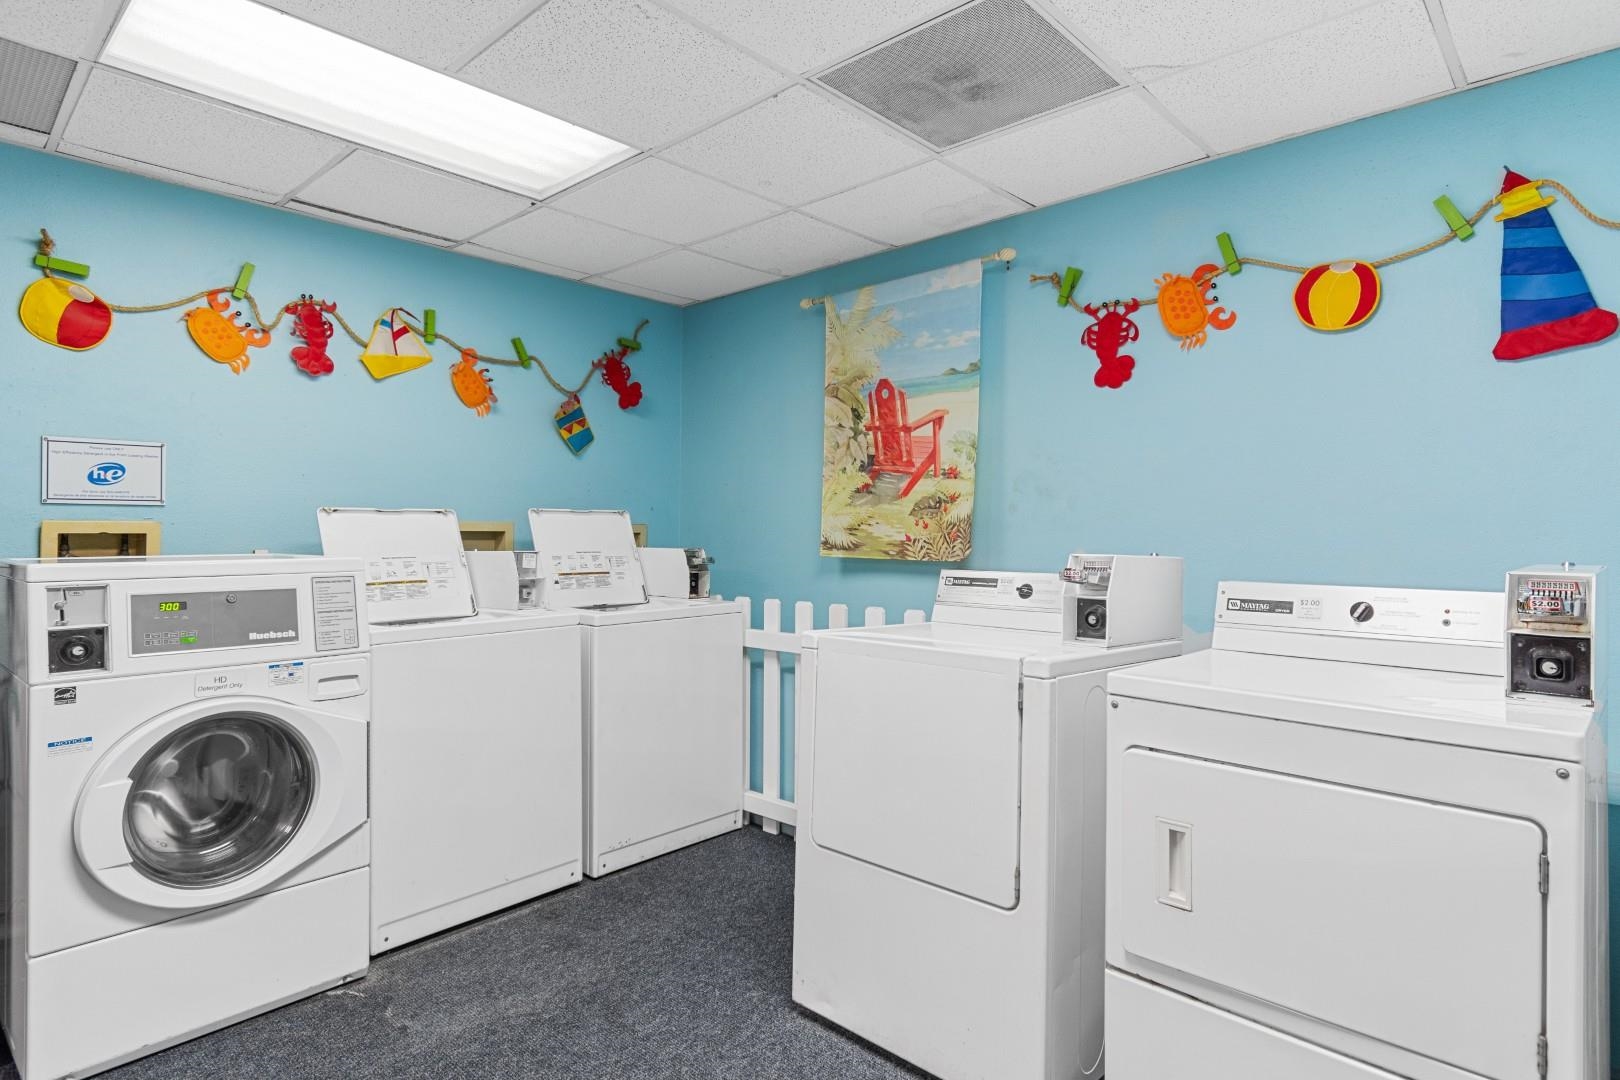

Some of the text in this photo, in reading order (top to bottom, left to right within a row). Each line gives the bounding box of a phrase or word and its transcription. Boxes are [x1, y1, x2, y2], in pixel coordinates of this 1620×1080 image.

[92, 466, 124, 482] he
[160, 602, 180, 612] 300
[1241, 602, 1270, 610] MAYTAG
[1532, 600, 1559, 608] $2.00
[249, 629, 296, 640] Huebsch
[214, 676, 228, 684] HD
[197, 684, 228, 692] Detergent
[54, 738, 84, 747] NOTICE
